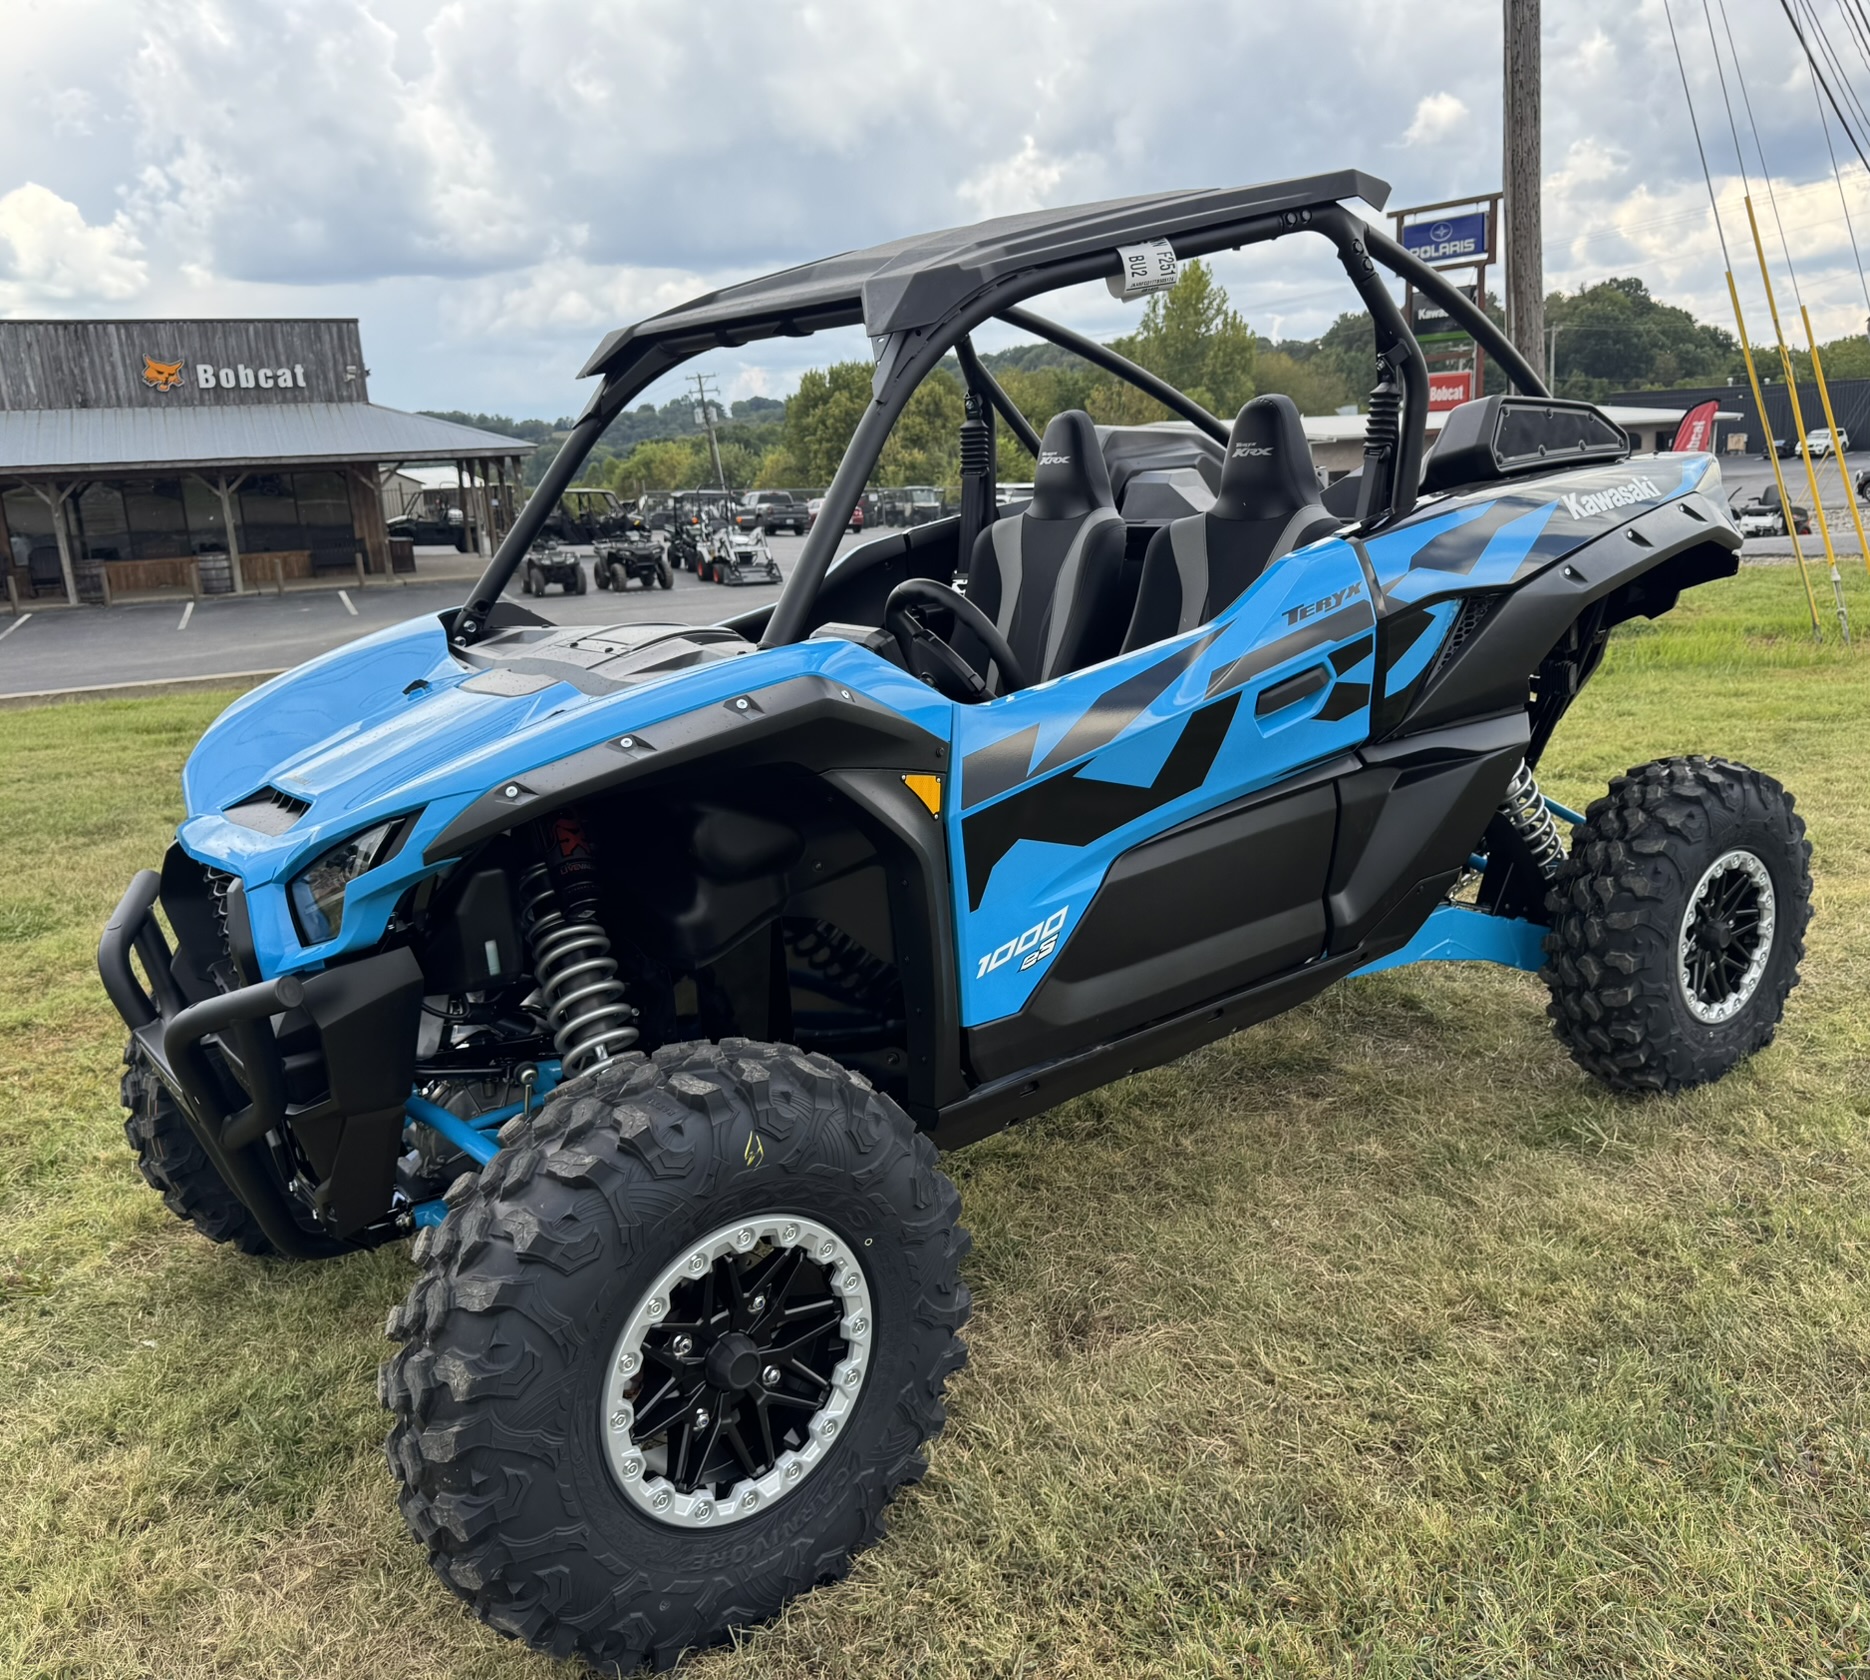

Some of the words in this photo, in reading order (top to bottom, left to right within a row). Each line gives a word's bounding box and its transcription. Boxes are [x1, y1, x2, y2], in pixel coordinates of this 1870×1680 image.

[1408, 239, 1476, 259] POLARIS
[1128, 255, 1148, 277] BU2
[1156, 251, 1176, 276] F251
[196, 364, 307, 389] Bobcat
[1430, 385, 1464, 402] Bobcat
[1686, 420, 1706, 451] bcat
[1039, 455, 1071, 466] KRX
[1231, 447, 1275, 458] KRX
[1561, 475, 1662, 520] Kawasaki
[976, 905, 1069, 979] 1000
[688, 1466, 852, 1571] CARNIVORE
